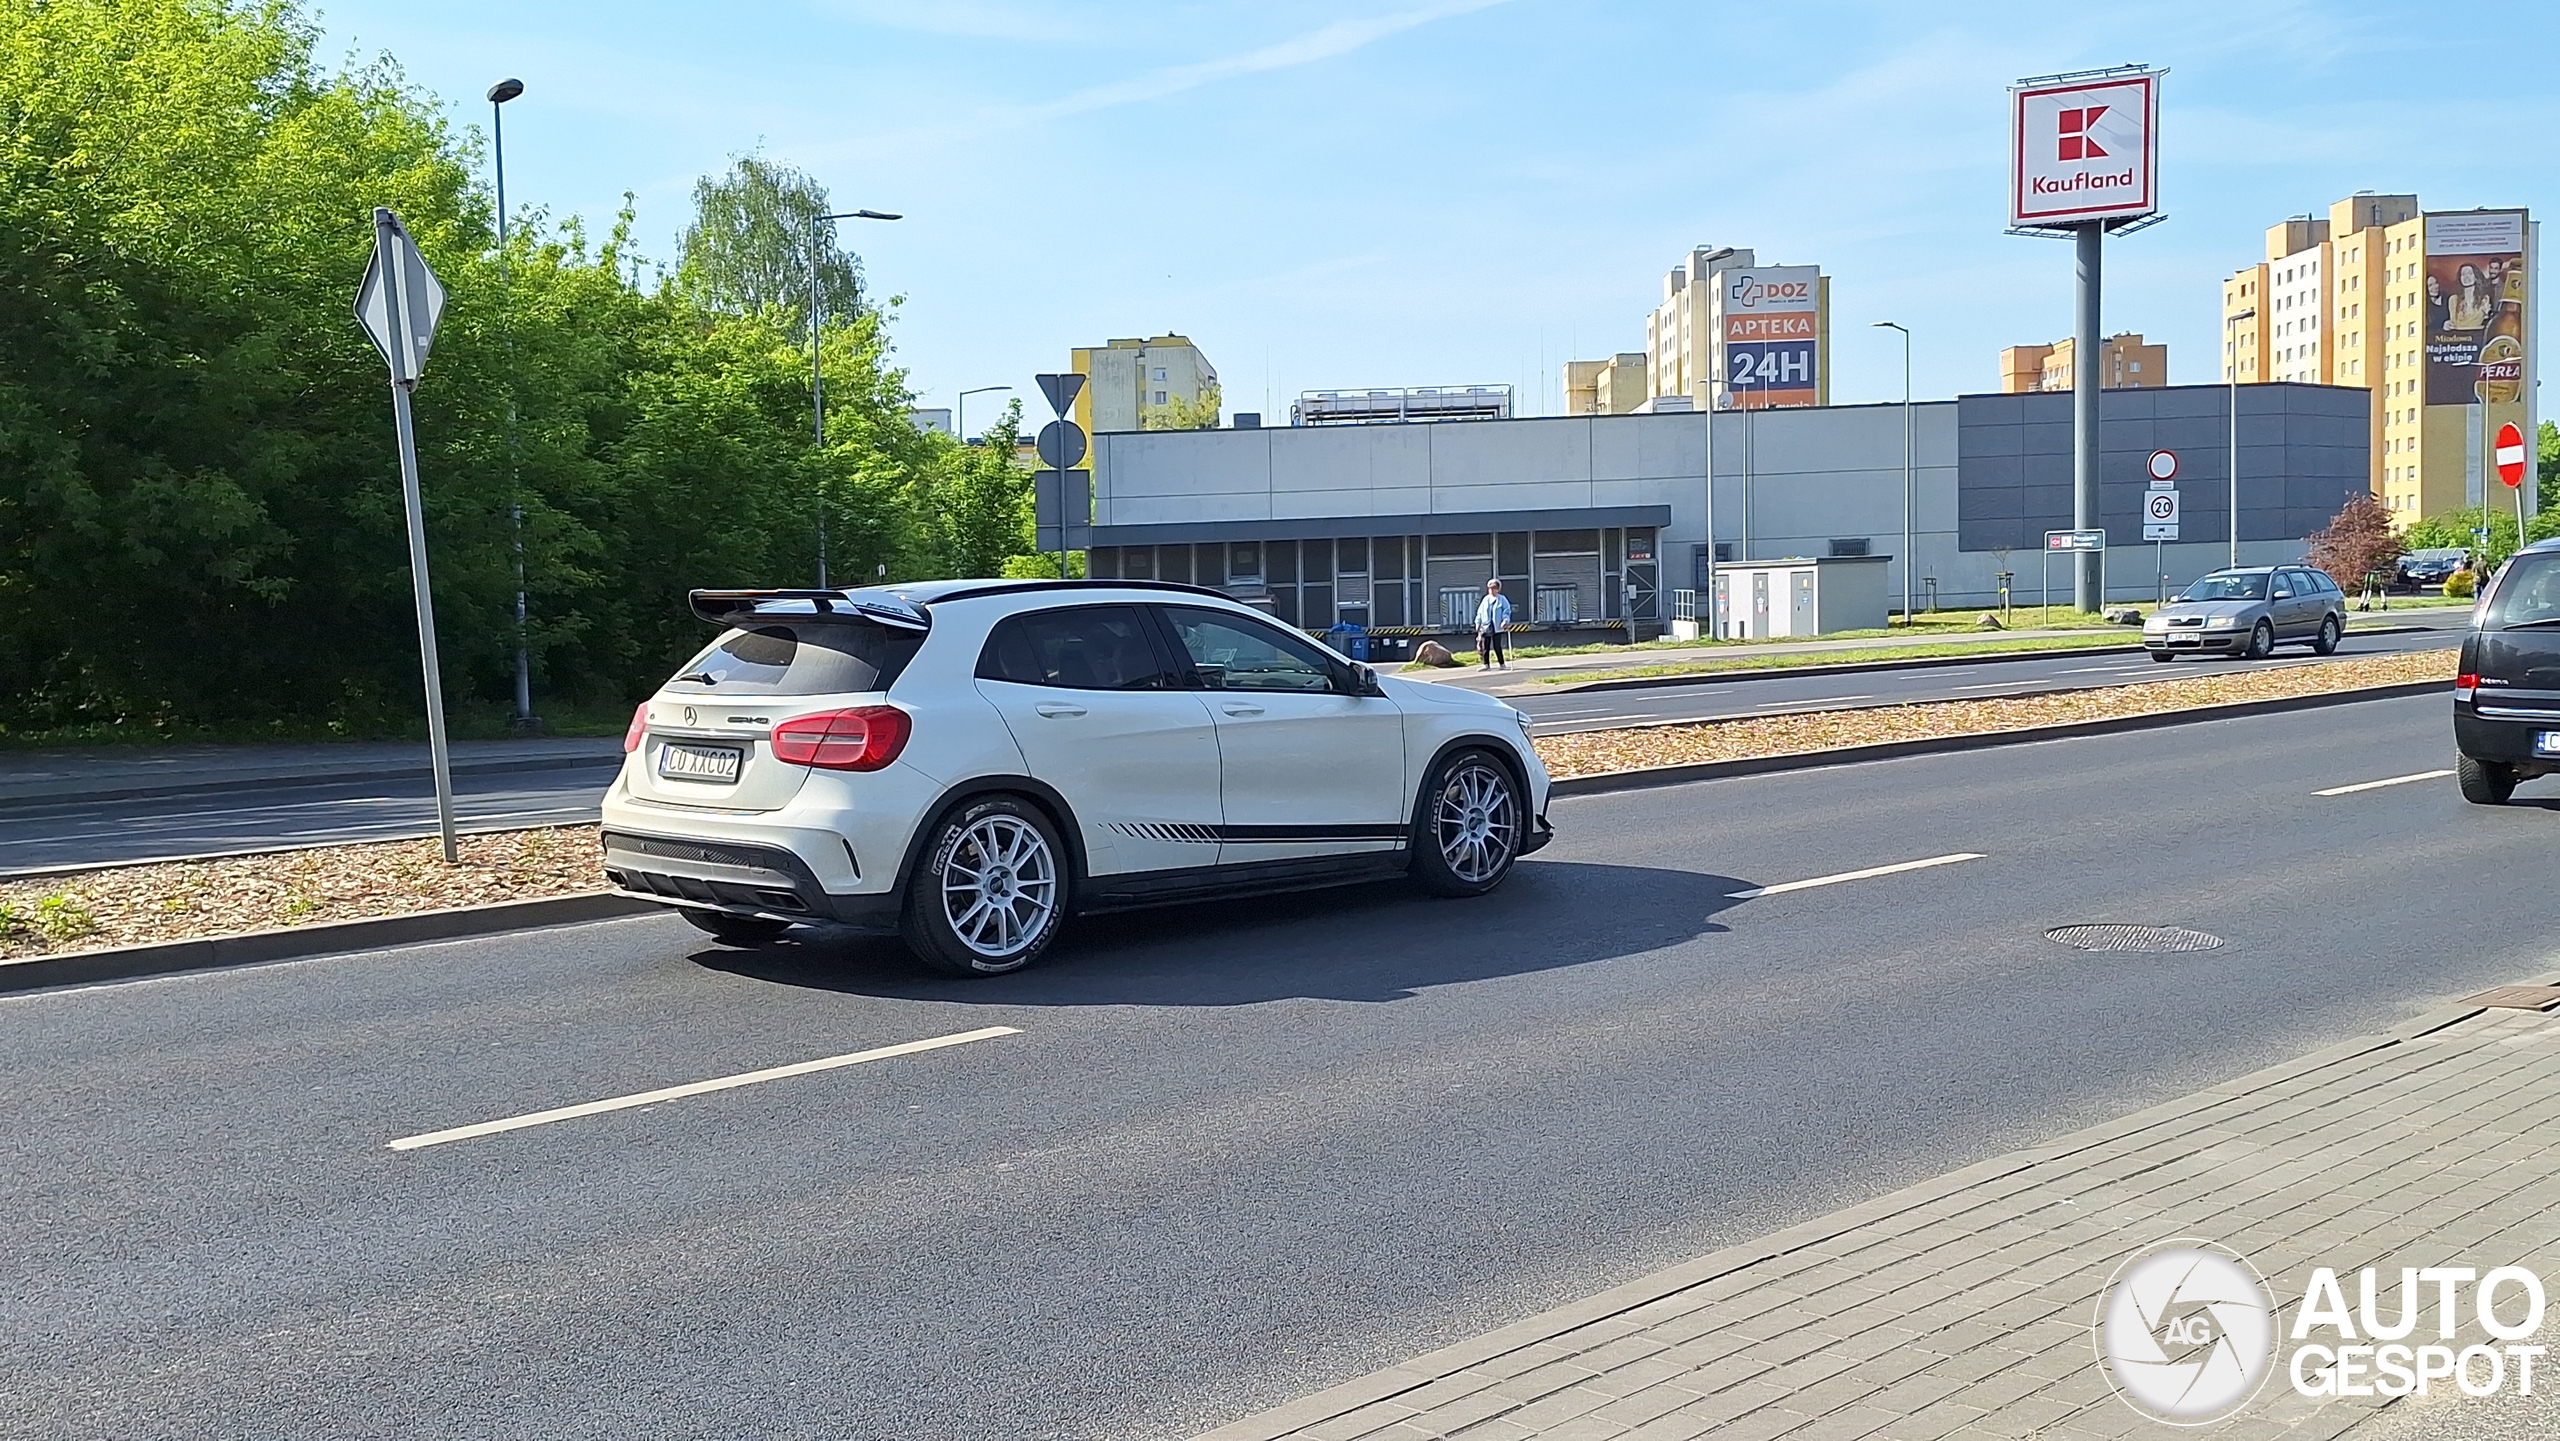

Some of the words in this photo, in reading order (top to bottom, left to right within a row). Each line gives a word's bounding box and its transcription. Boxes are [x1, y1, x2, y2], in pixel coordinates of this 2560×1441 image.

[2032, 168, 2133, 195] Kaufland
[1767, 283, 1808, 298] DOZ
[1730, 318, 1811, 336] APTEKA
[2426, 344, 2478, 355] Najsłodsza
[2433, 355, 2442, 363] w
[1732, 350, 1809, 384] 24H
[2480, 366, 2520, 378] PERŁA
[2155, 501, 2171, 514] 20
